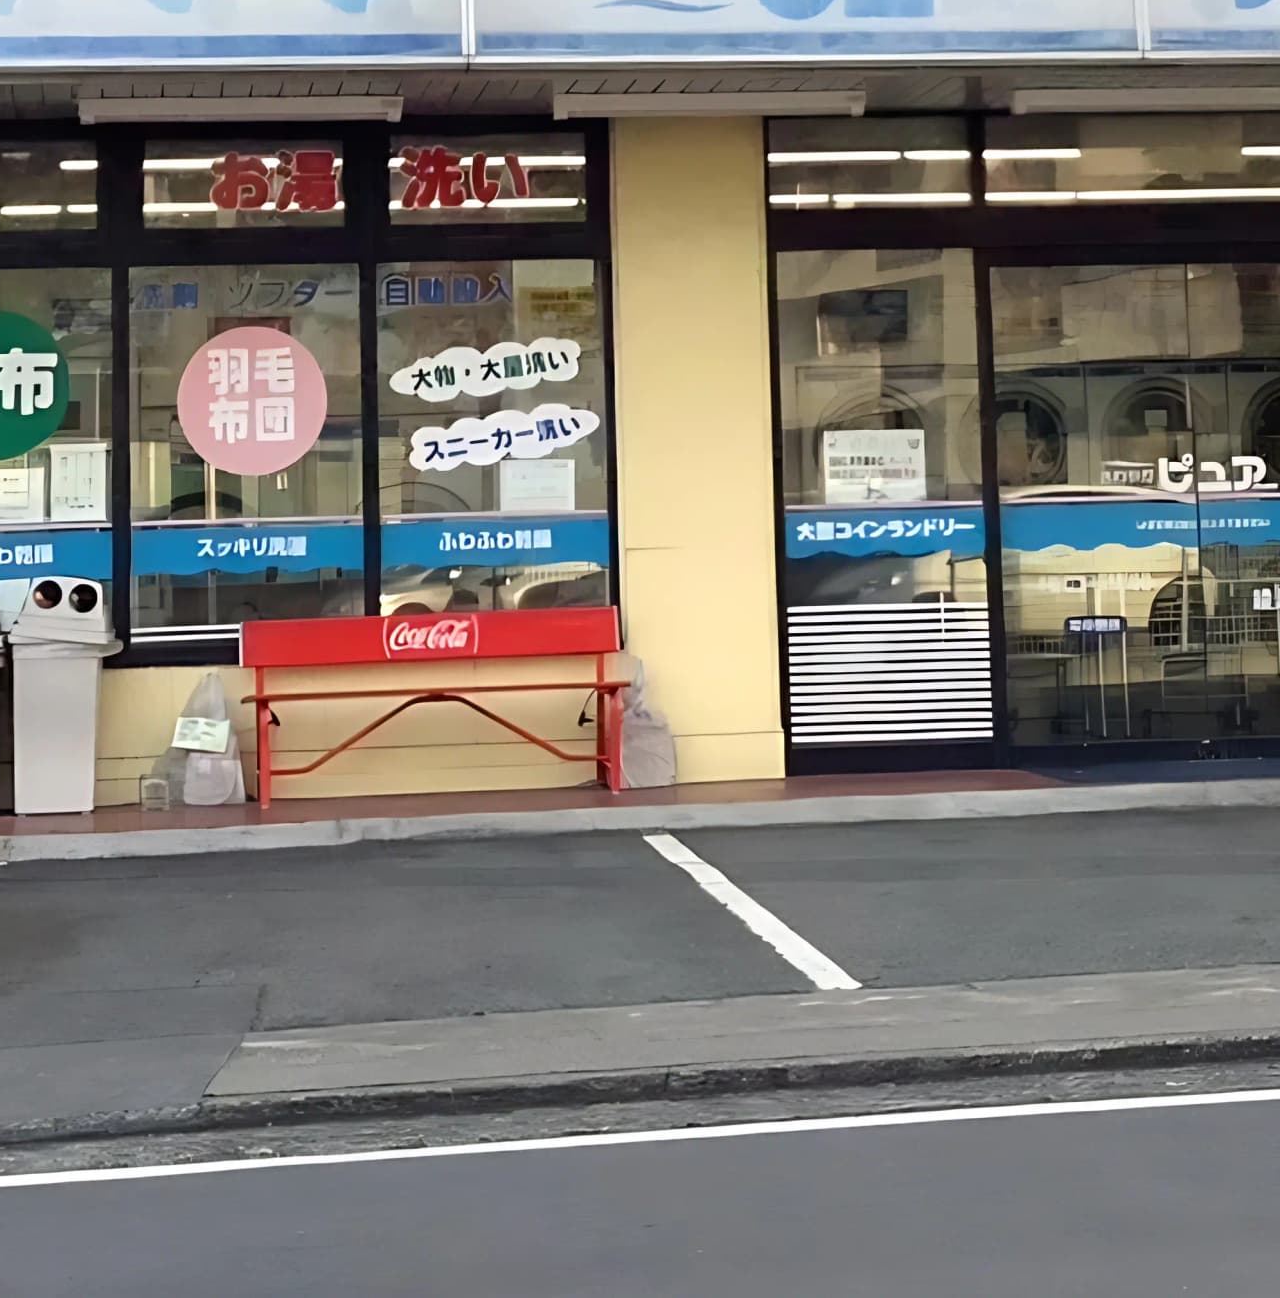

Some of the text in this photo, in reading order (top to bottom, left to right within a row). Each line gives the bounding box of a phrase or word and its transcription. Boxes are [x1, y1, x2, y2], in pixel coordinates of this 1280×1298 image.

[209, 144, 530, 213] お湯 洗い
[206, 345, 296, 395] 羽毛
[207, 396, 296, 444] 布団
[423, 416, 581, 463] スニーカー洗い
[1157, 453, 1278, 492] ピュア
[196, 535, 307, 558] スッキリ洗
[438, 529, 552, 552] ふわふわ
[796, 518, 976, 541] 大コインランドリー
